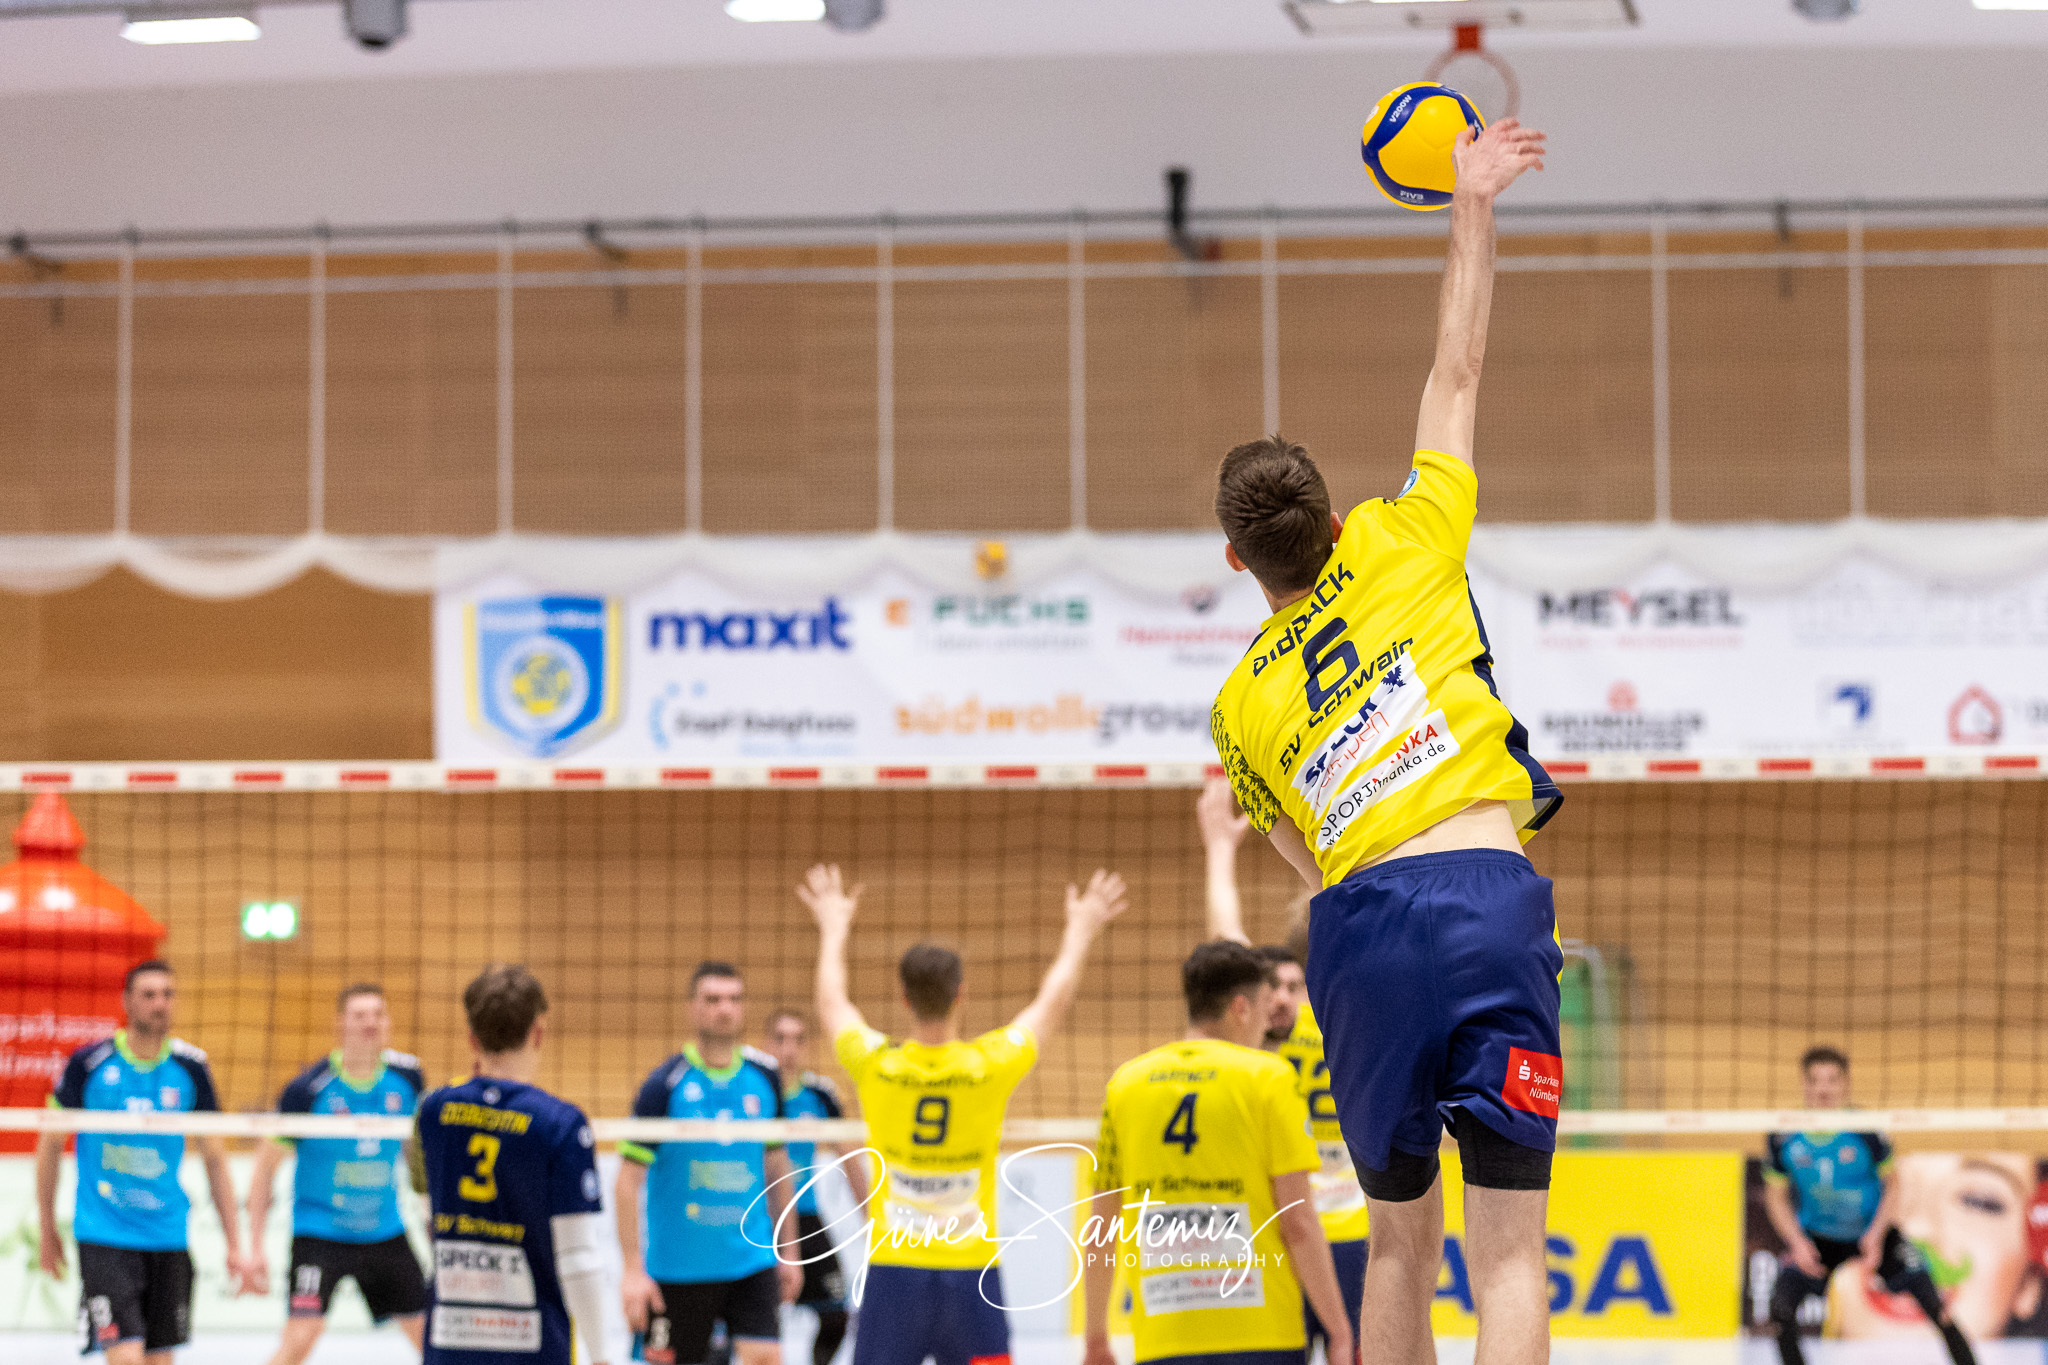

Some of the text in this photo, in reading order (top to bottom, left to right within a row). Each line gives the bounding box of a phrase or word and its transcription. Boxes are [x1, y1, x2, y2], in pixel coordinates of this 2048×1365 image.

[1389, 94, 1412, 123] V200W
[649, 596, 852, 650] maxit
[1539, 590, 1743, 626] MEYSEL
[1301, 616, 1361, 712] 6
[1279, 733, 1301, 776] SV
[912, 1096, 950, 1145] 9
[1163, 1092, 1199, 1154] 4
[458, 1132, 500, 1203] 3
